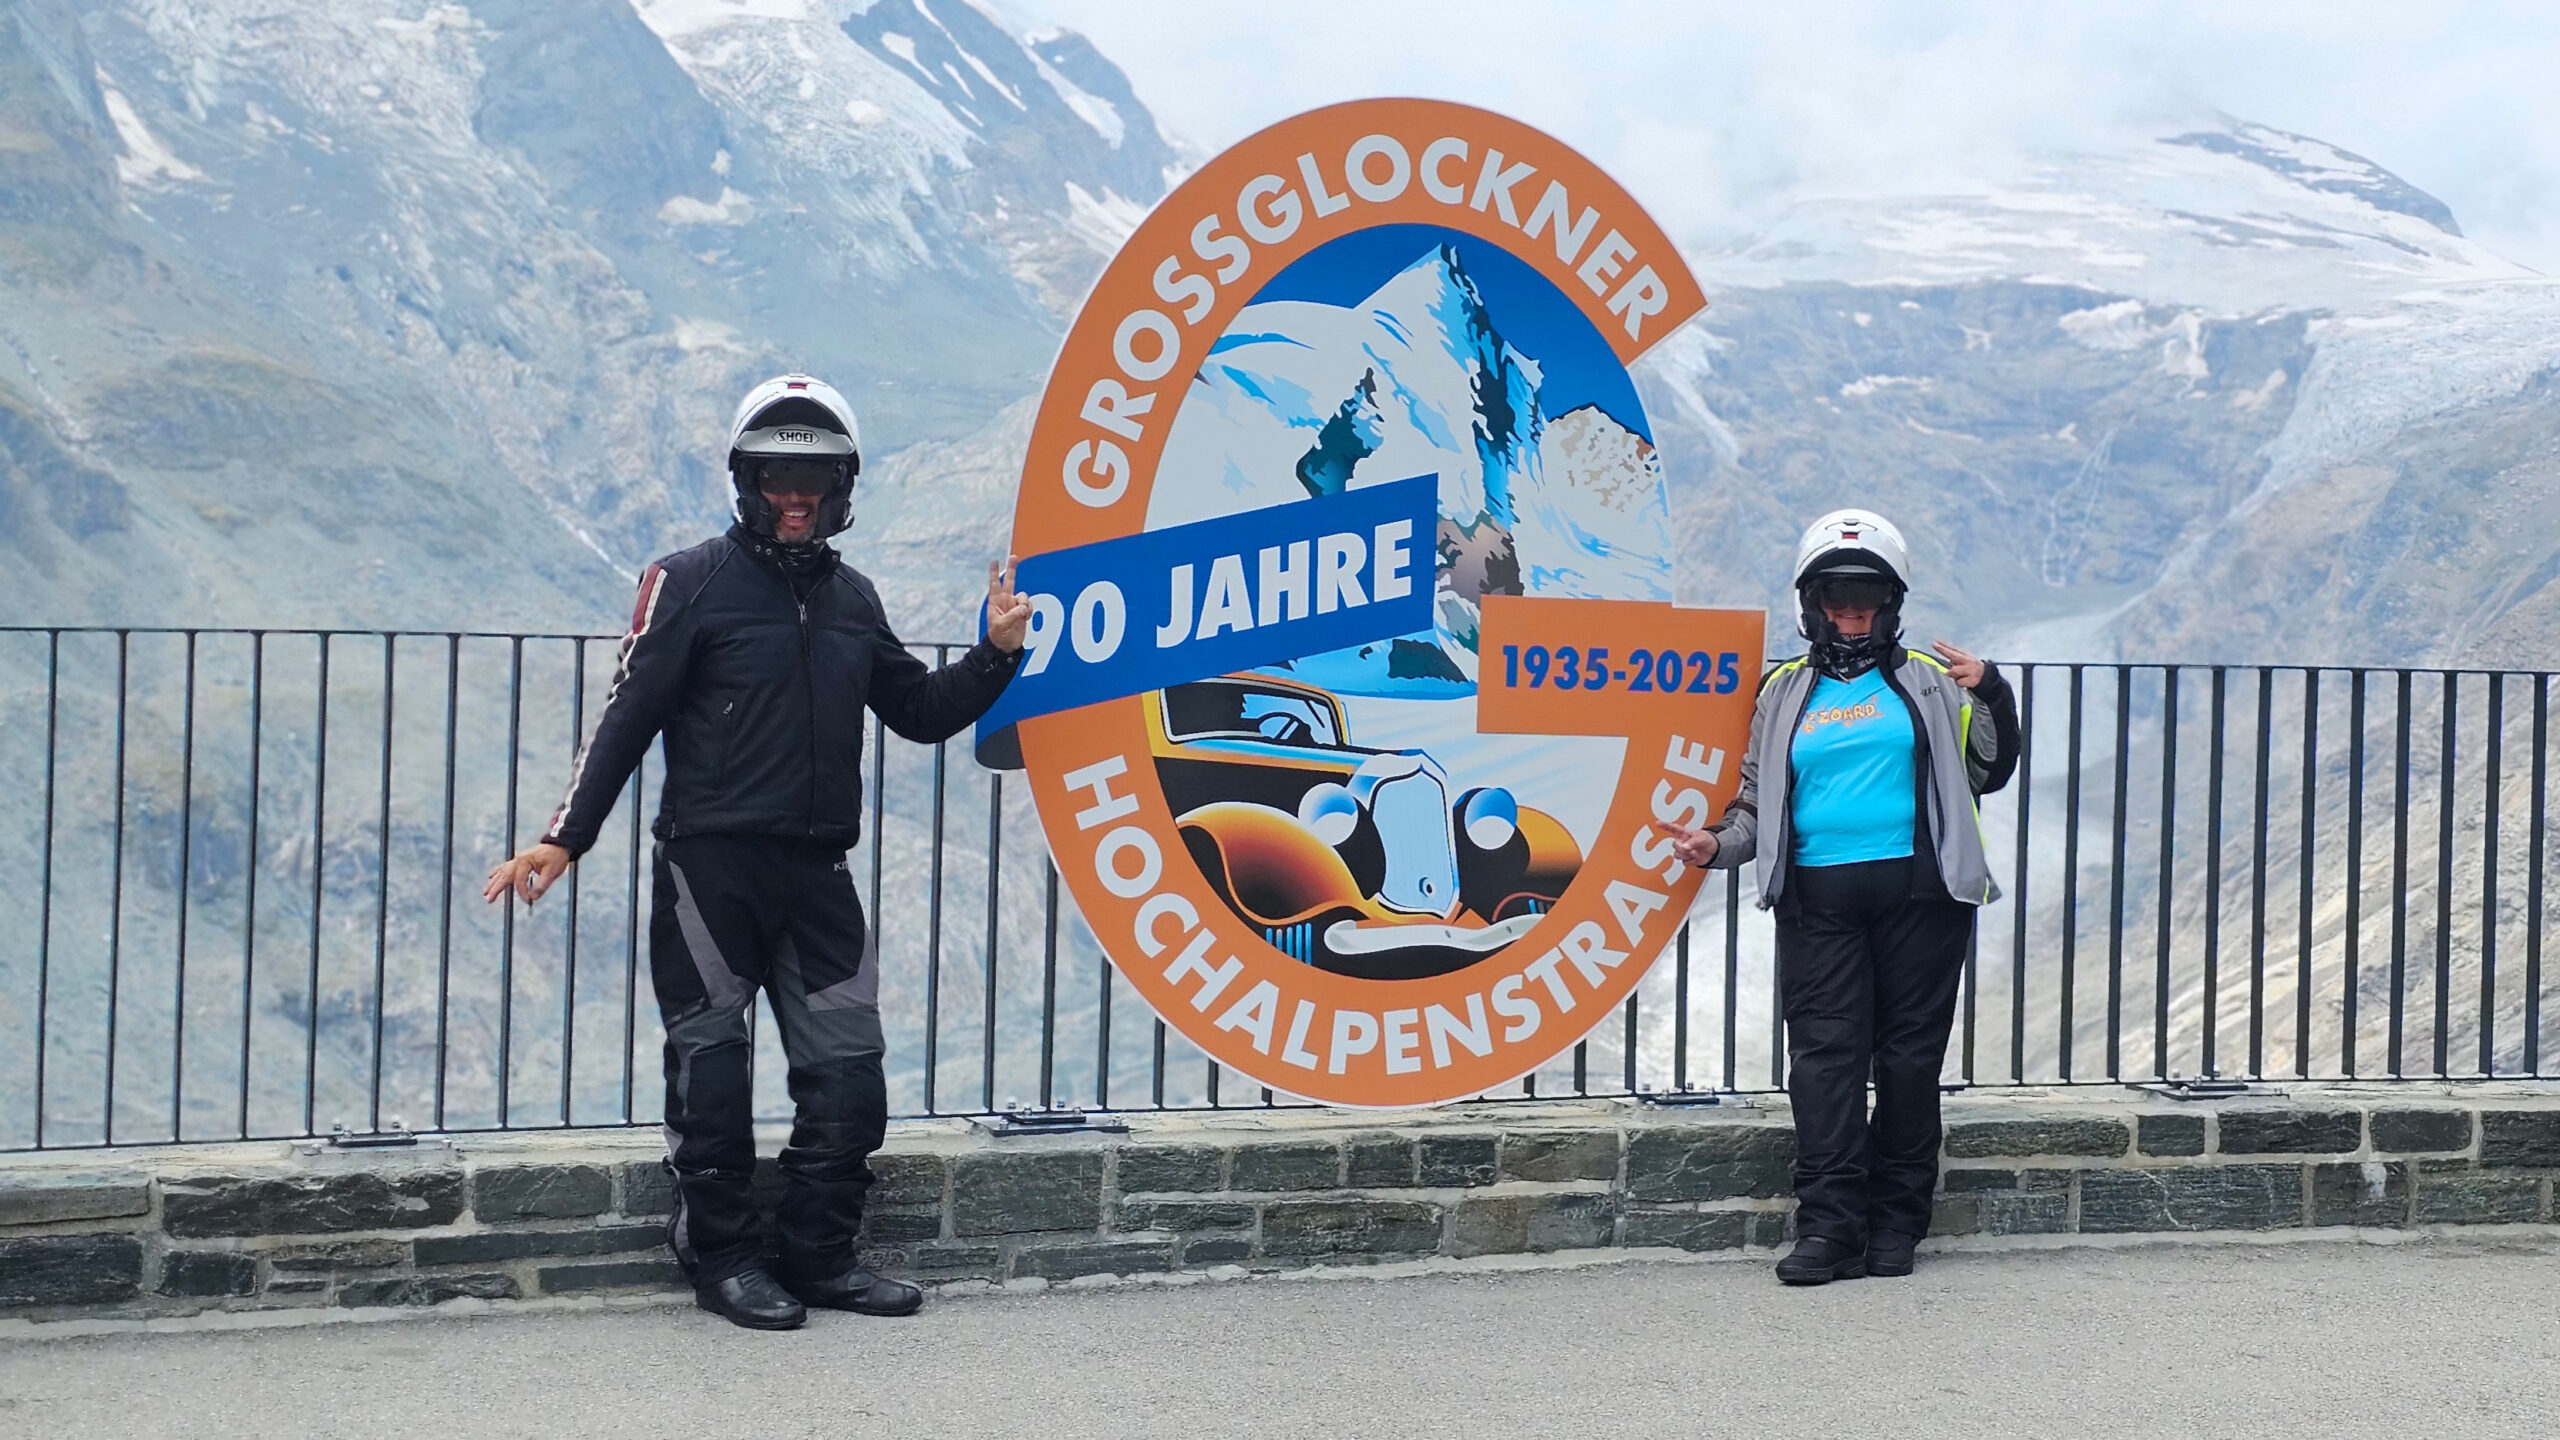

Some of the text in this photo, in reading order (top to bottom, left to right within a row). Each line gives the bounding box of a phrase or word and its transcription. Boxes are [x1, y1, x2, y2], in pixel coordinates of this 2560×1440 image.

[1062, 134, 1669, 507] GROSSGLOCKNER
[779, 431, 813, 443] SHOEI
[1021, 518, 1412, 677] 90 JAHRE
[1502, 644, 1740, 695] 1935-2025
[1062, 734, 1726, 1076] HOCHALPENSTRASSE
